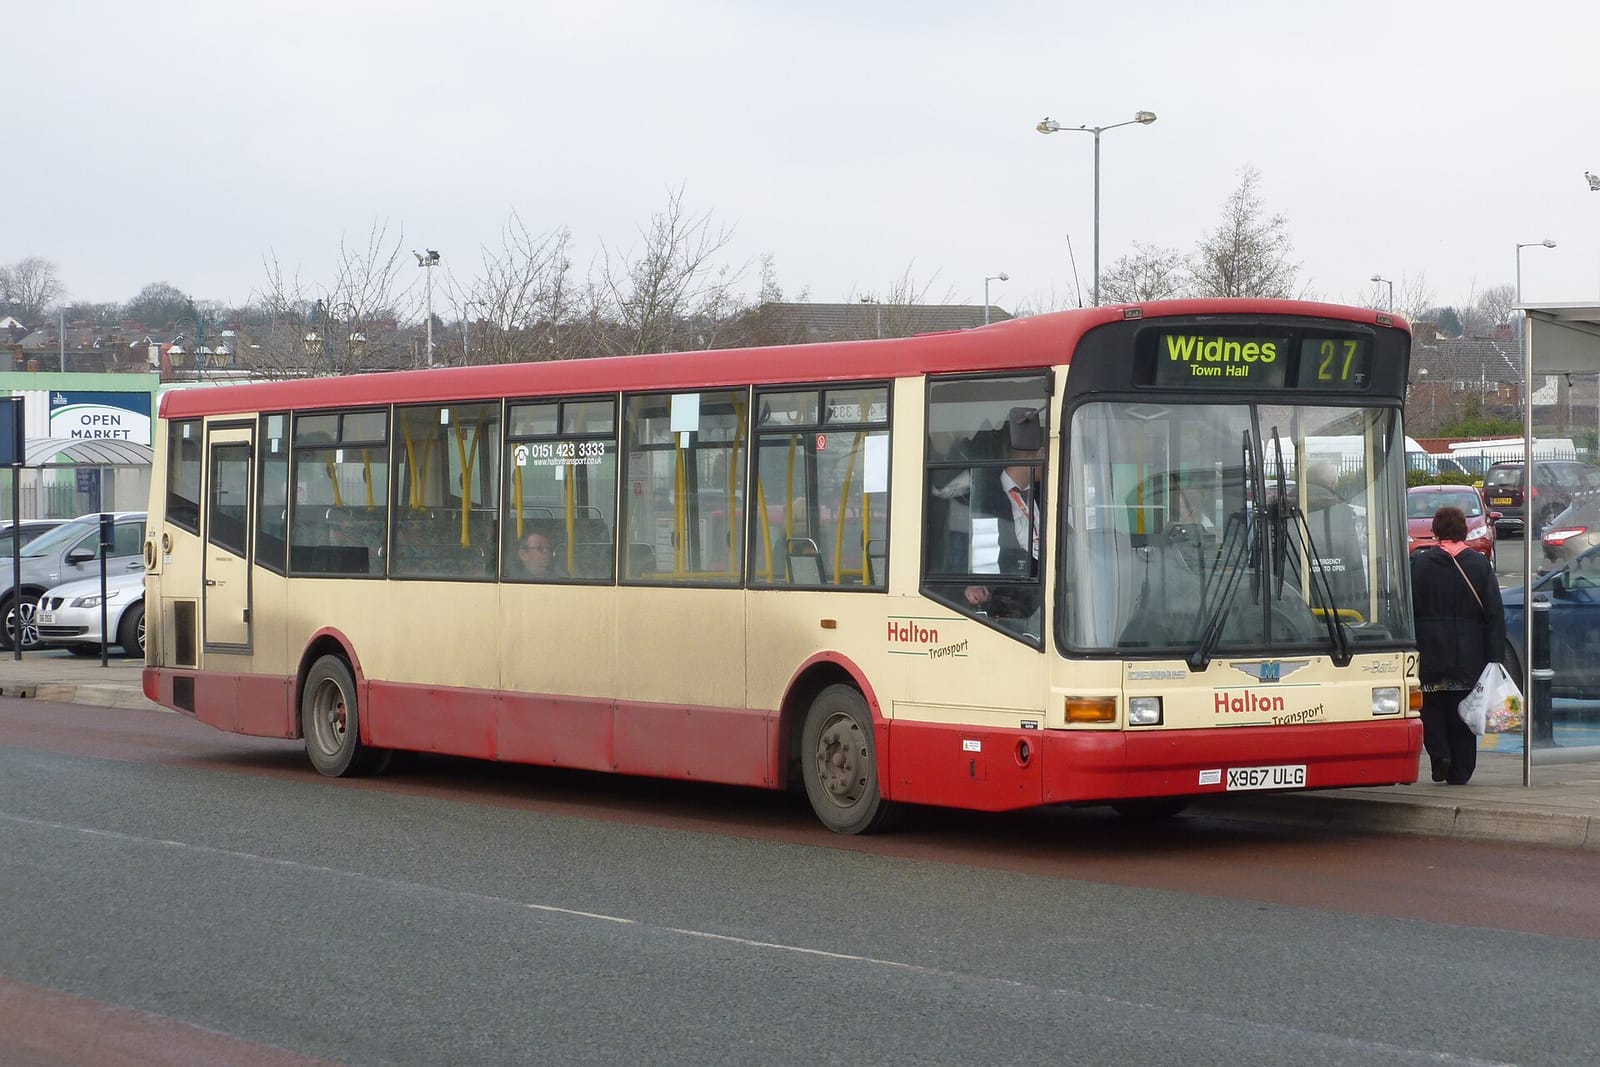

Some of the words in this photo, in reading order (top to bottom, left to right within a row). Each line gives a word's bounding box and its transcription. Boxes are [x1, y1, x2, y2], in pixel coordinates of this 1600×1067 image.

[1166, 335, 1276, 363] Widnes
[1317, 340, 1358, 380] 27
[1190, 365, 1221, 376] Town
[1226, 365, 1249, 376] Hall
[81, 414, 121, 426] OPEN
[71, 429, 131, 440] MARKET
[532, 444, 553, 458] 0151
[556, 443, 575, 457] 423
[579, 442, 605, 457] 3333
[533, 456, 602, 466] www.haltontransport.co.uk
[888, 620, 939, 643] Halton
[929, 638, 968, 660] Transport
[1128, 670, 1186, 680] DENNIS
[1214, 690, 1285, 714] Halton
[1272, 703, 1324, 726] Transport
[1228, 769, 1270, 787] X967
[1273, 768, 1304, 785] ULG
